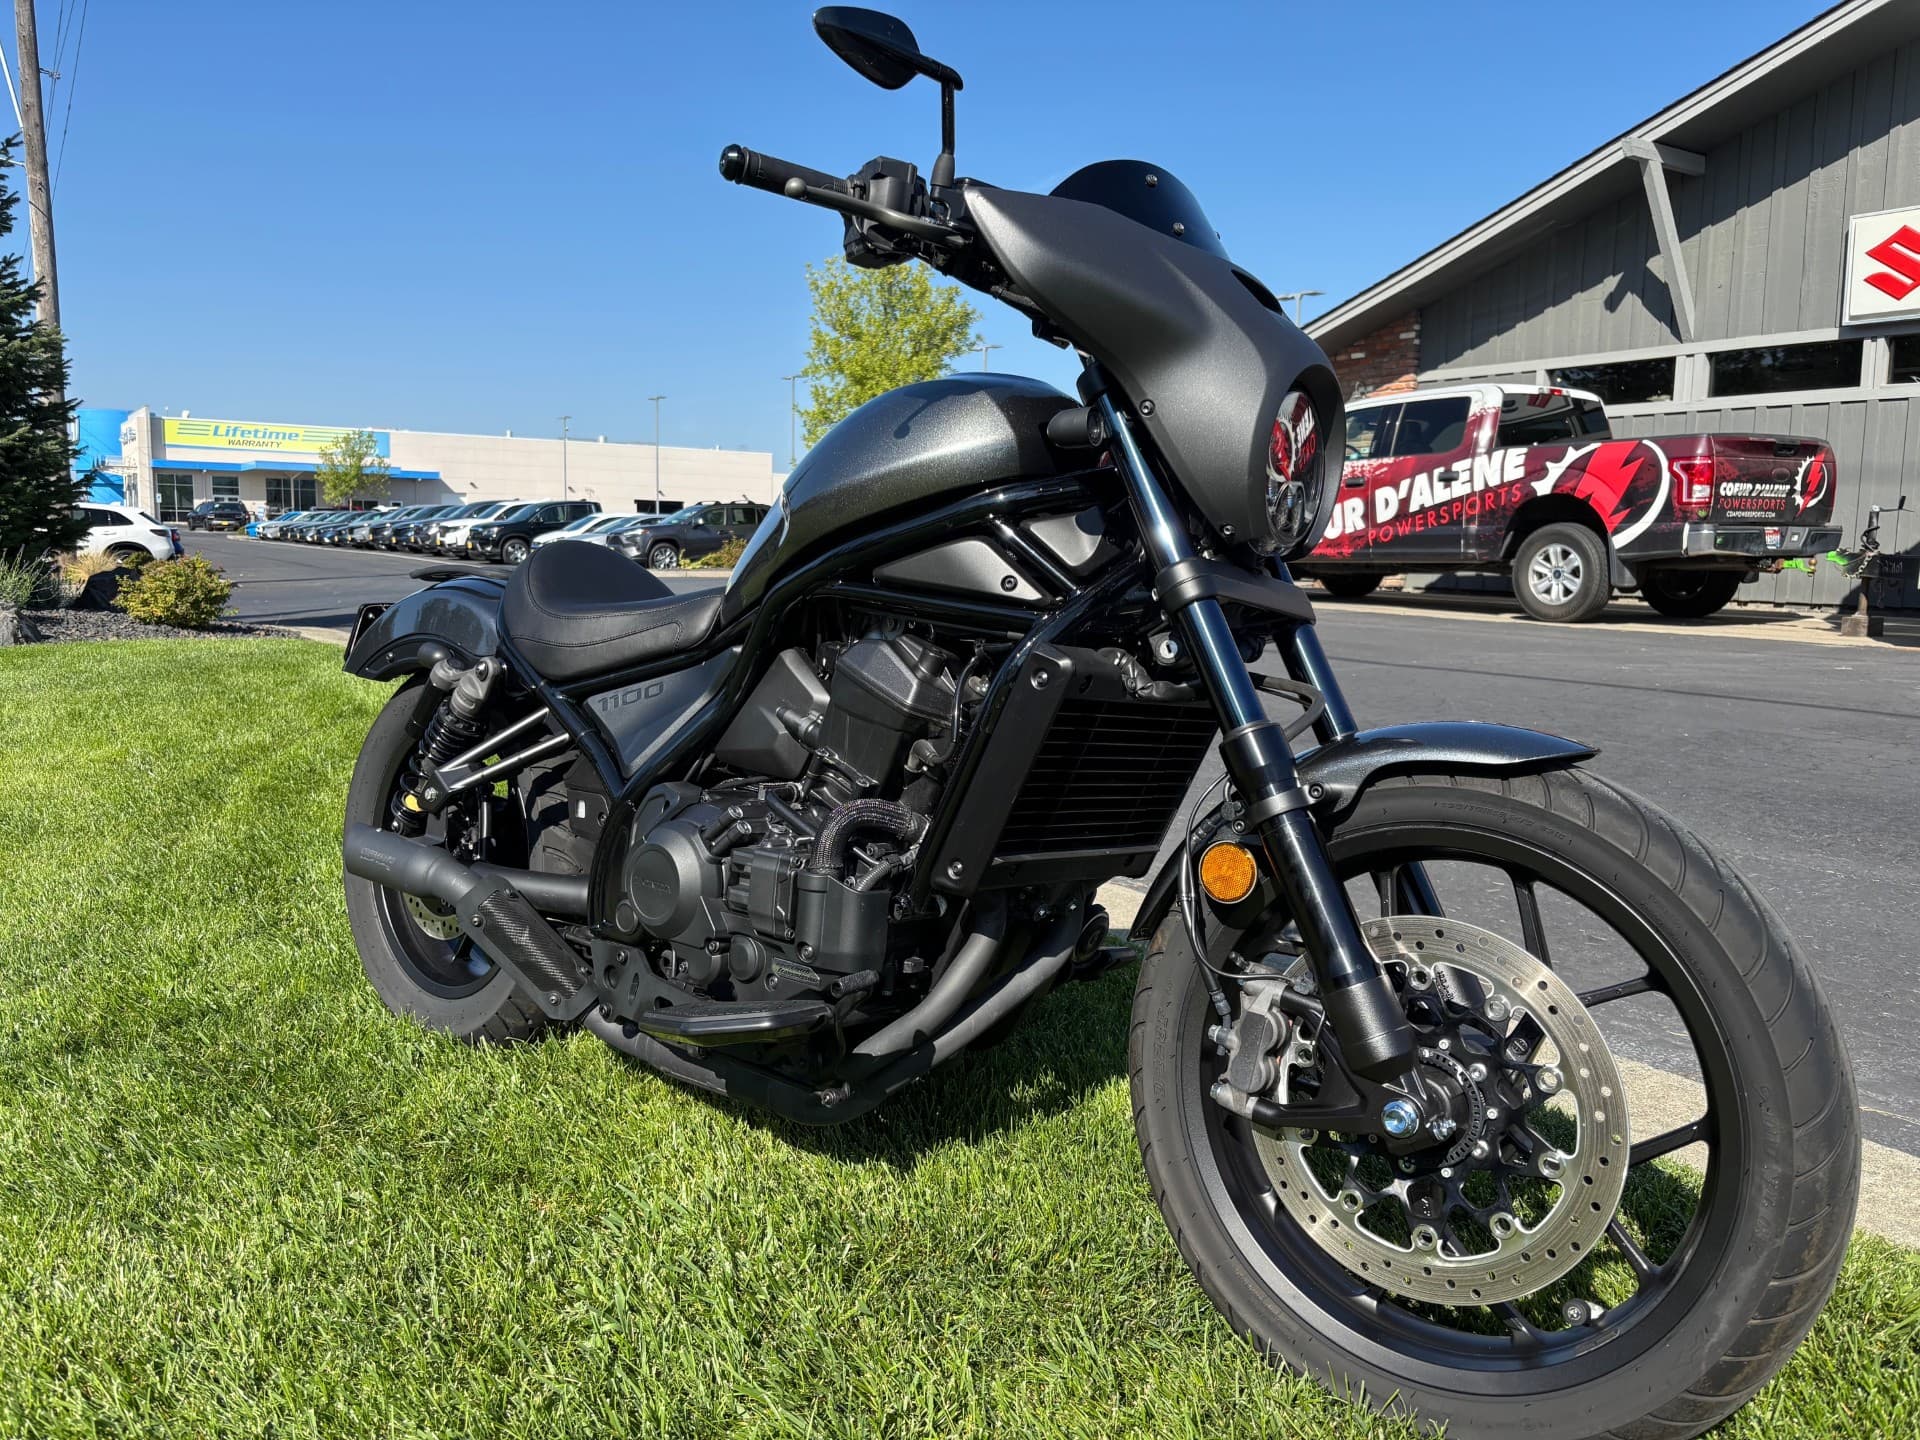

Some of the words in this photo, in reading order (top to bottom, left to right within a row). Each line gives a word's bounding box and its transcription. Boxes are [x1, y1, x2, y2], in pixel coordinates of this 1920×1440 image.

[213, 425, 299, 440] Lifetime
[228, 439, 282, 448] WARRANTY
[1718, 498, 1786, 510] POWERSPORTS
[1368, 483, 1523, 546] POWERSPORTS
[598, 681, 664, 712] 1100
